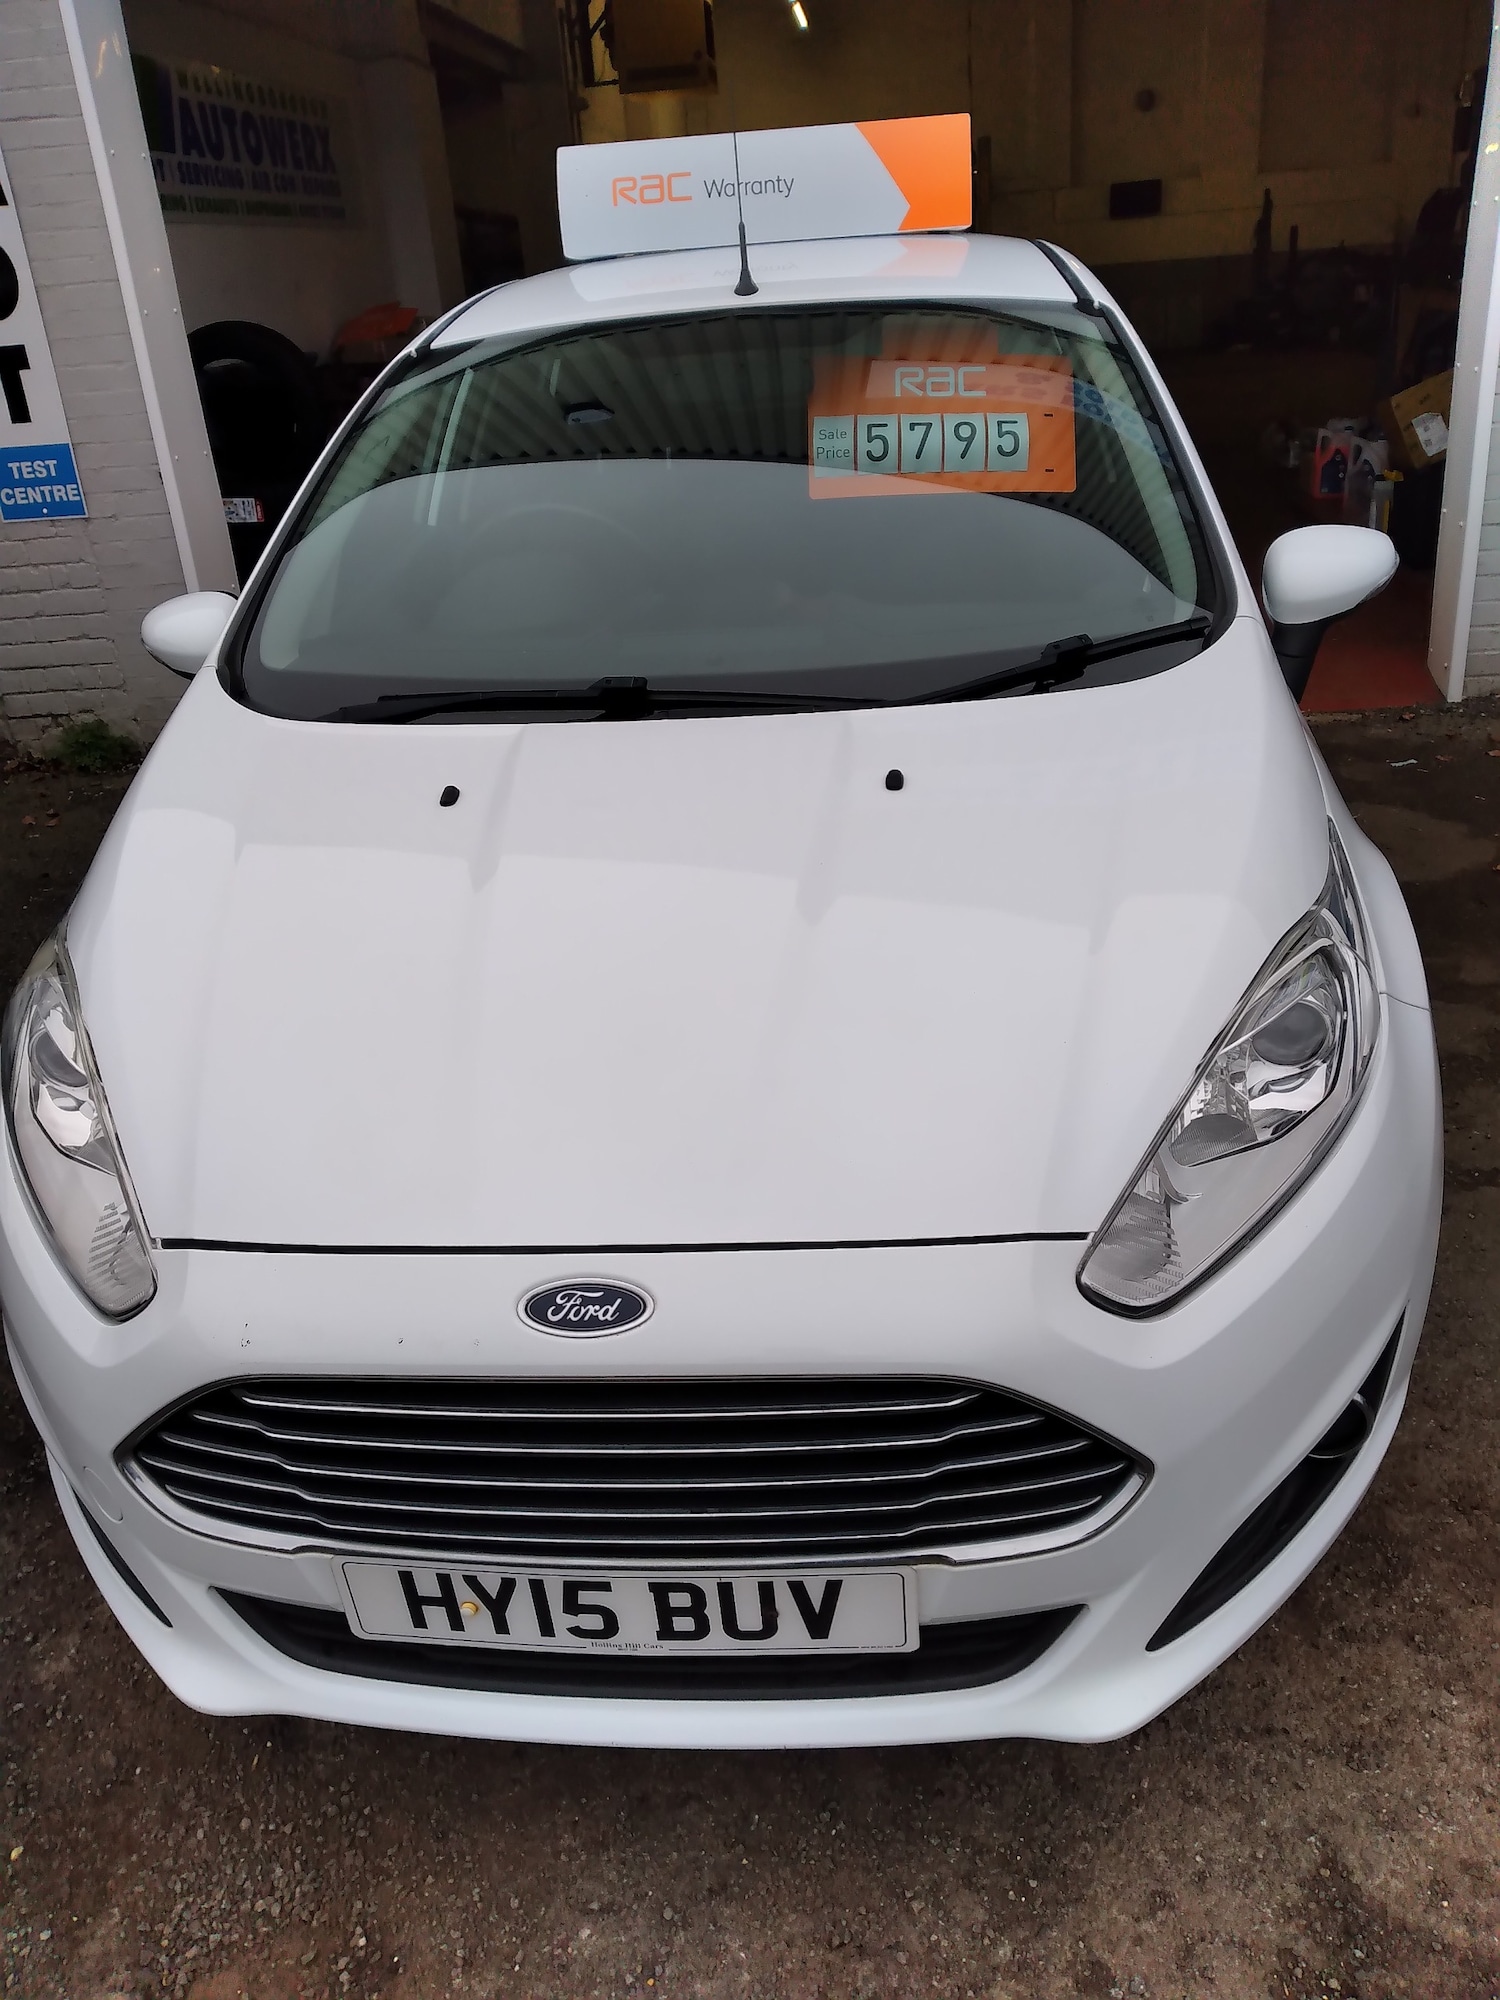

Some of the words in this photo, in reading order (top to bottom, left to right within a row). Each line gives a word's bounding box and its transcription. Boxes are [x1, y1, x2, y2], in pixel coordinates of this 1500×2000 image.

[179, 97, 337, 173] AUTOWERX
[703, 175, 795, 199] Warranty
[818, 429, 848, 441] Sale
[866, 420, 1020, 462] 5795
[816, 446, 850, 460] Price
[7, 460, 58, 480] TEST
[0, 484, 81, 505] CENTRE
[547, 1290, 622, 1322] Ford
[397, 1570, 621, 1641] HY15
[647, 1579, 844, 1641] BUV
